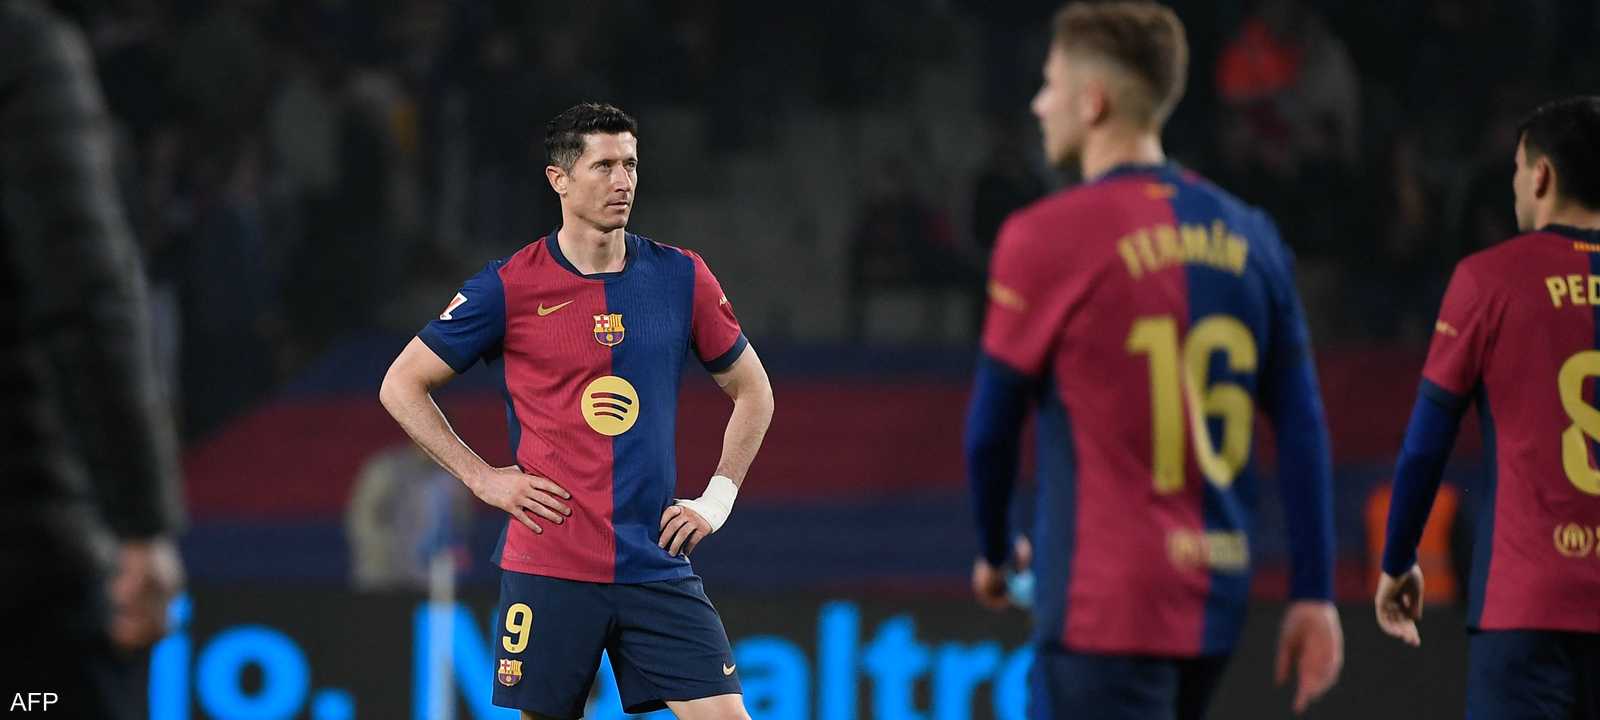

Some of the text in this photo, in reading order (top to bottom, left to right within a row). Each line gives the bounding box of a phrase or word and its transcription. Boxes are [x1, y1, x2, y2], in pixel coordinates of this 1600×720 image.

[1126, 314, 1257, 494] 16
[1557, 350, 1600, 496] 8
[502, 603, 533, 654] 9
